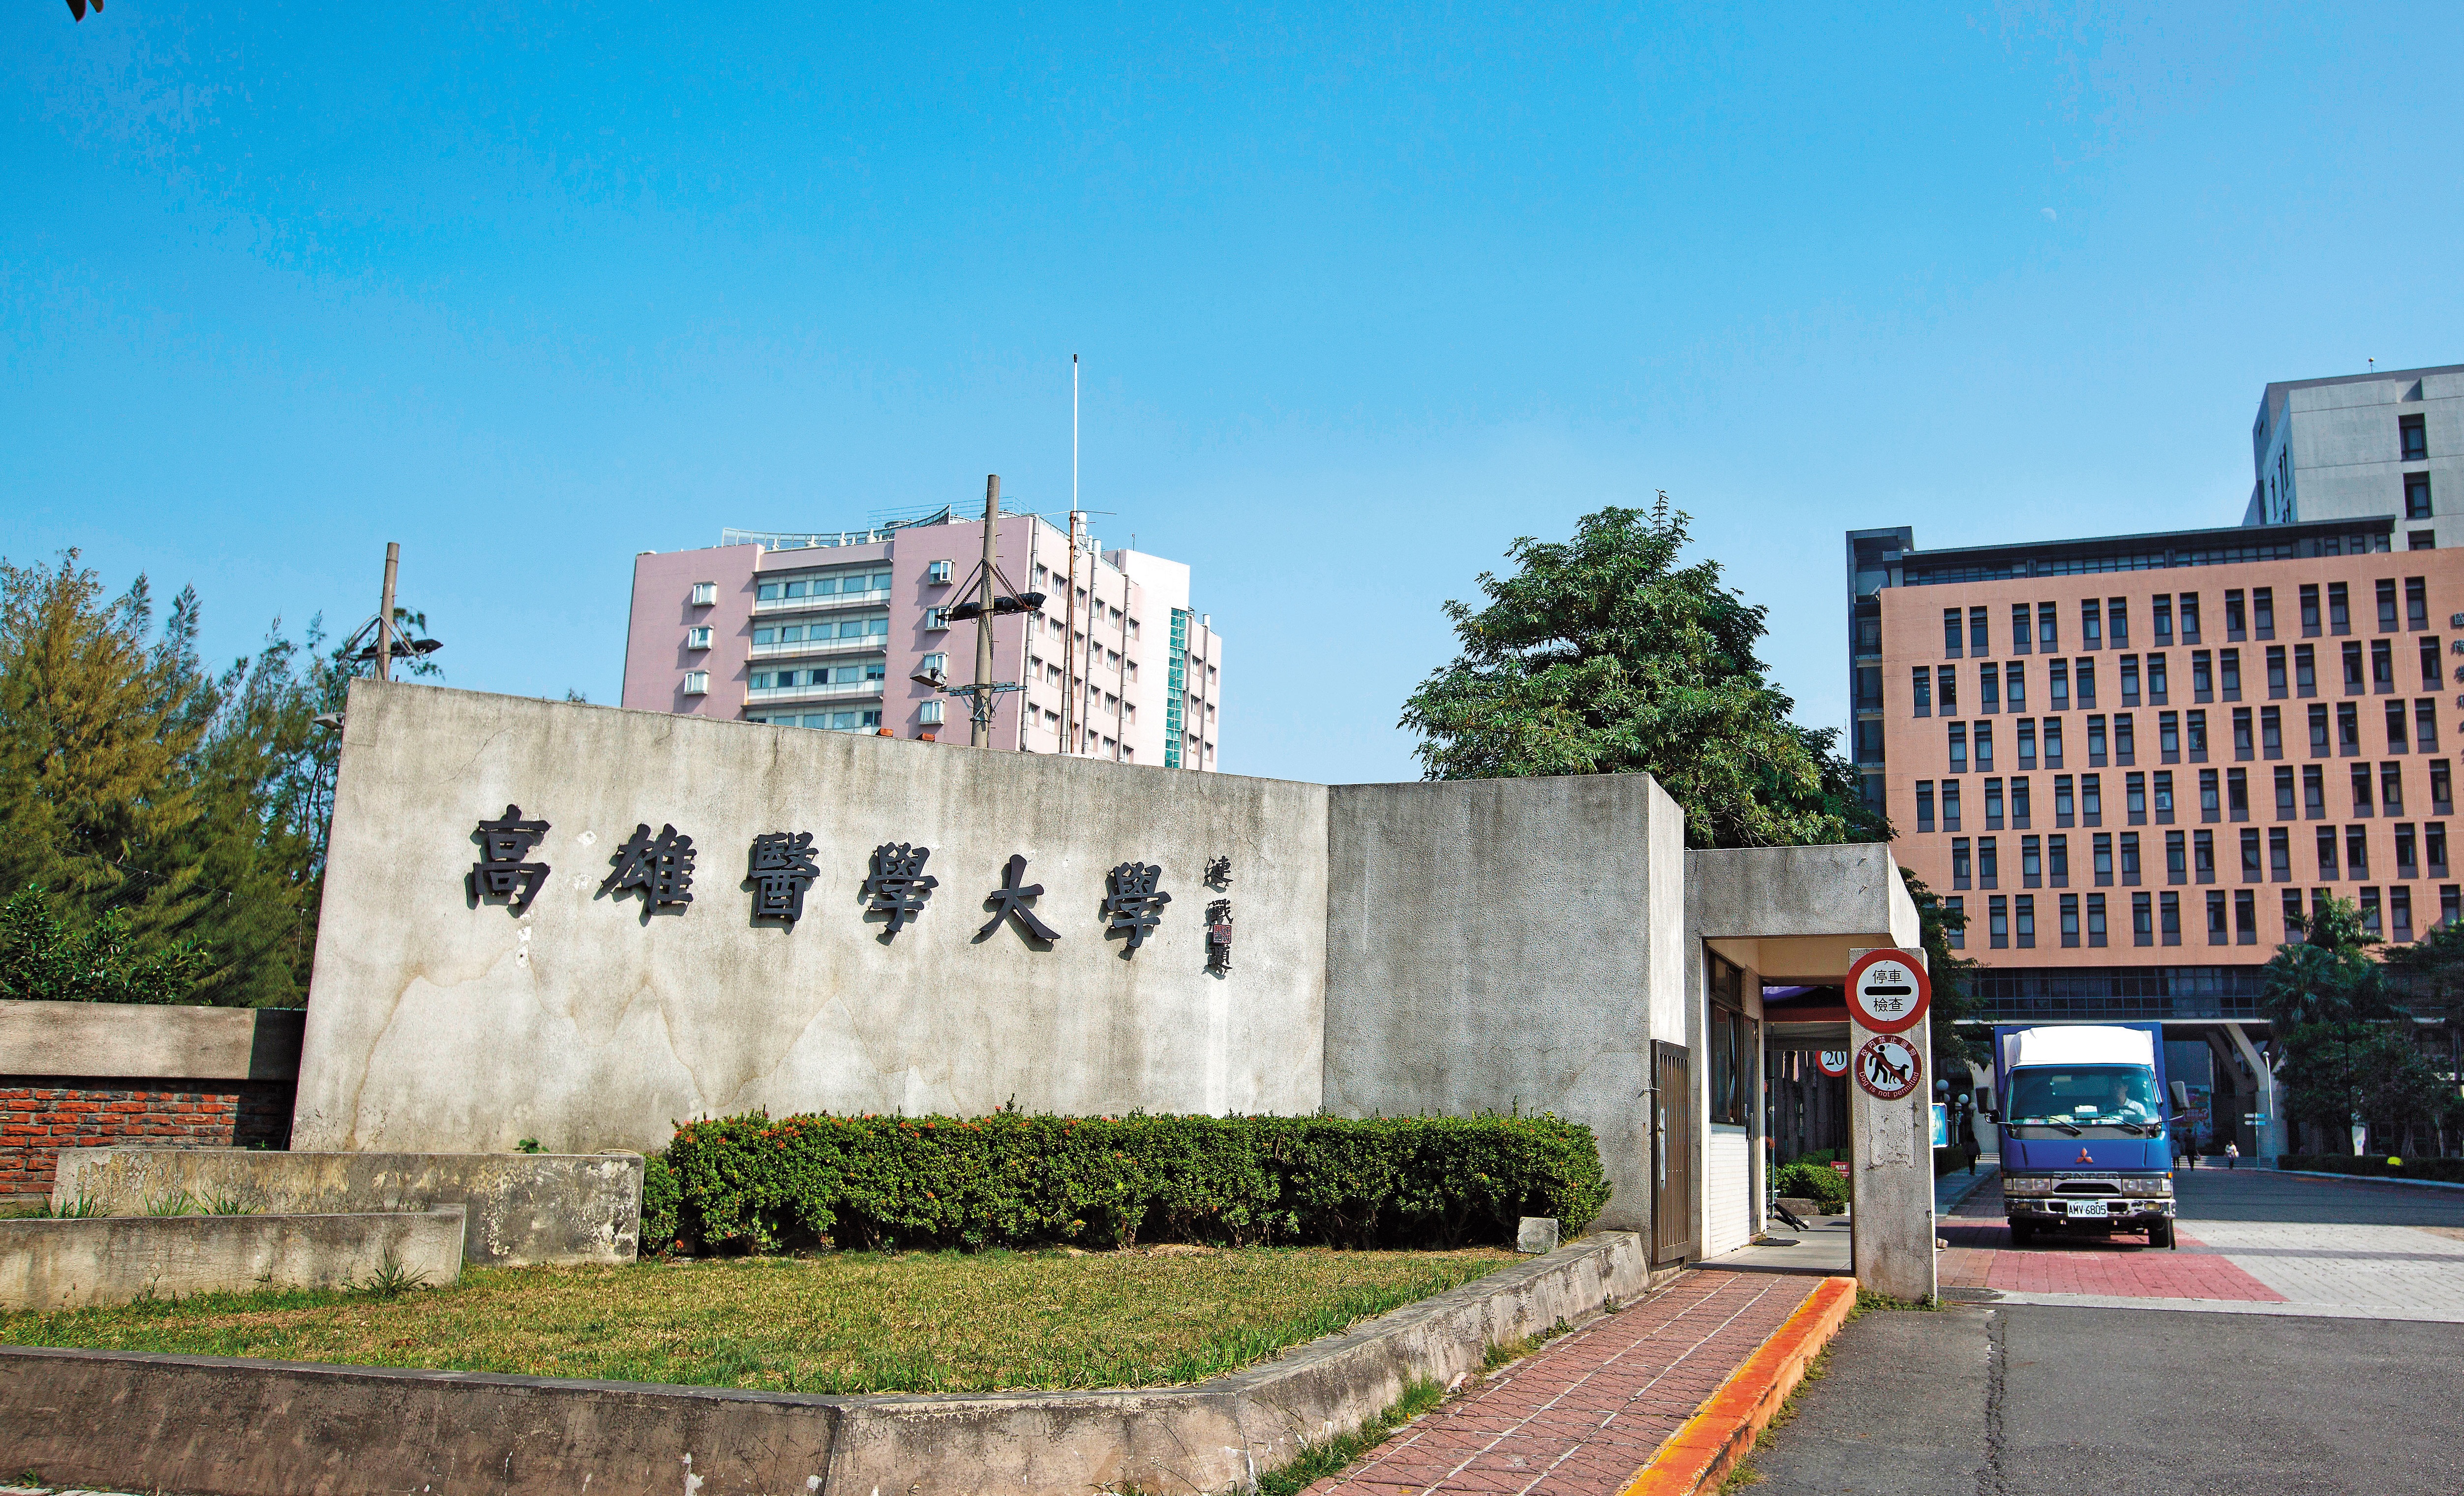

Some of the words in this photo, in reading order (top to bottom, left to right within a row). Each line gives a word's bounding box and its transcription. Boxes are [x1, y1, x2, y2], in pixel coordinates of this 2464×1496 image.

[473, 804, 1172, 948] 高雄醫學大學
[1872, 969, 1902, 984] 停車
[1873, 997, 1903, 1012] 檢查
[1825, 1051, 1845, 1066] 20
[1859, 1071, 1869, 1086] Dog
[1893, 1072, 1919, 1098] permitted
